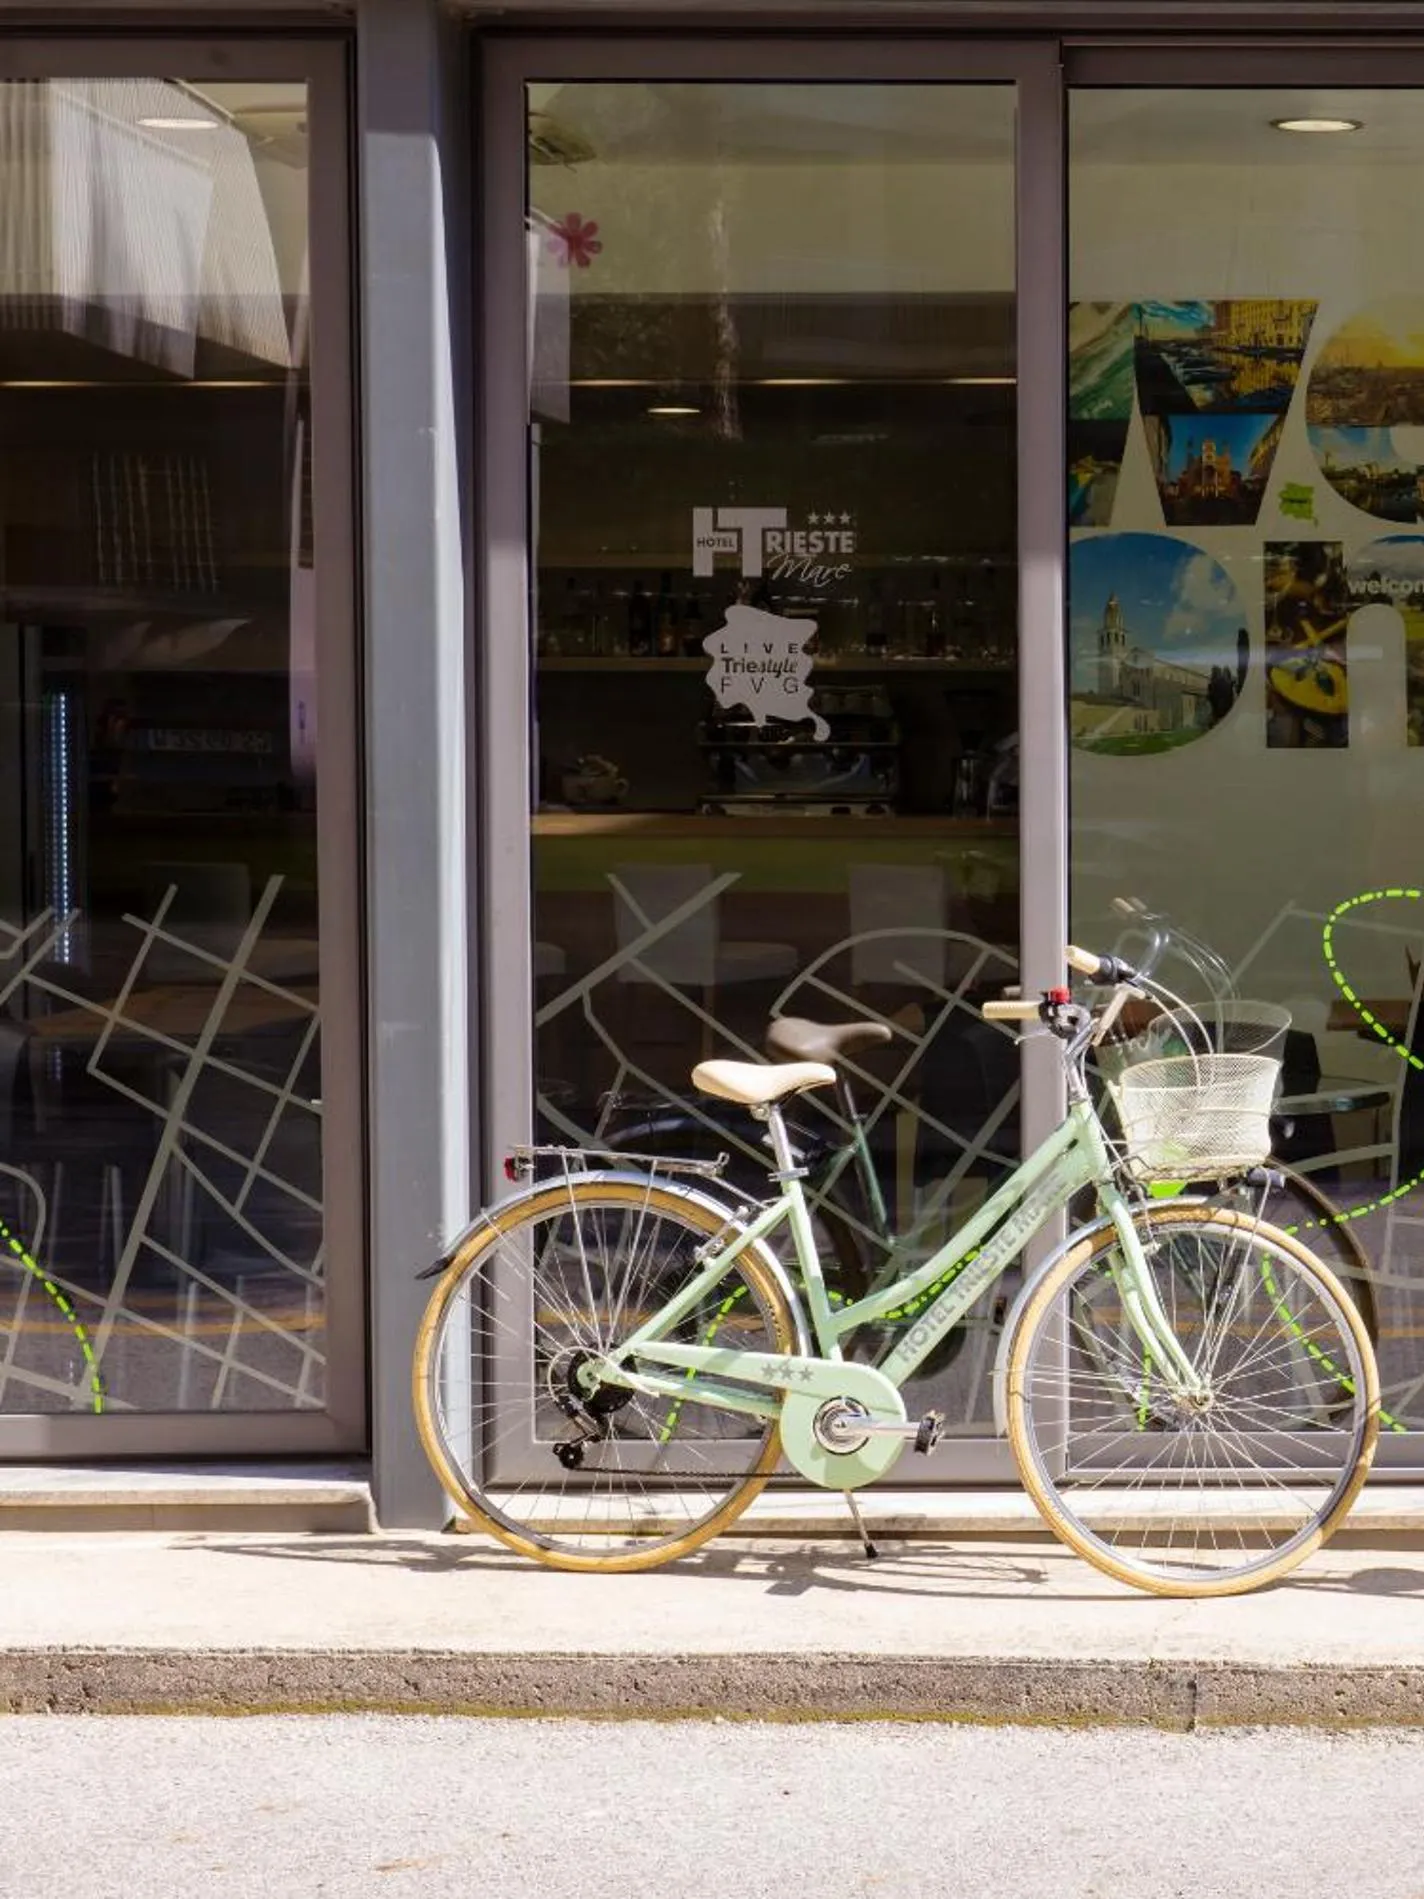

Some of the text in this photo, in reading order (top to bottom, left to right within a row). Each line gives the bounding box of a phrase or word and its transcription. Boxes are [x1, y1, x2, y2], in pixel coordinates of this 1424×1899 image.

[696, 537, 735, 549] HOTEL
[766, 552, 853, 588] Mare
[894, 1295, 957, 1364] HOTEL
[949, 1226, 1018, 1301] TRIESTE
